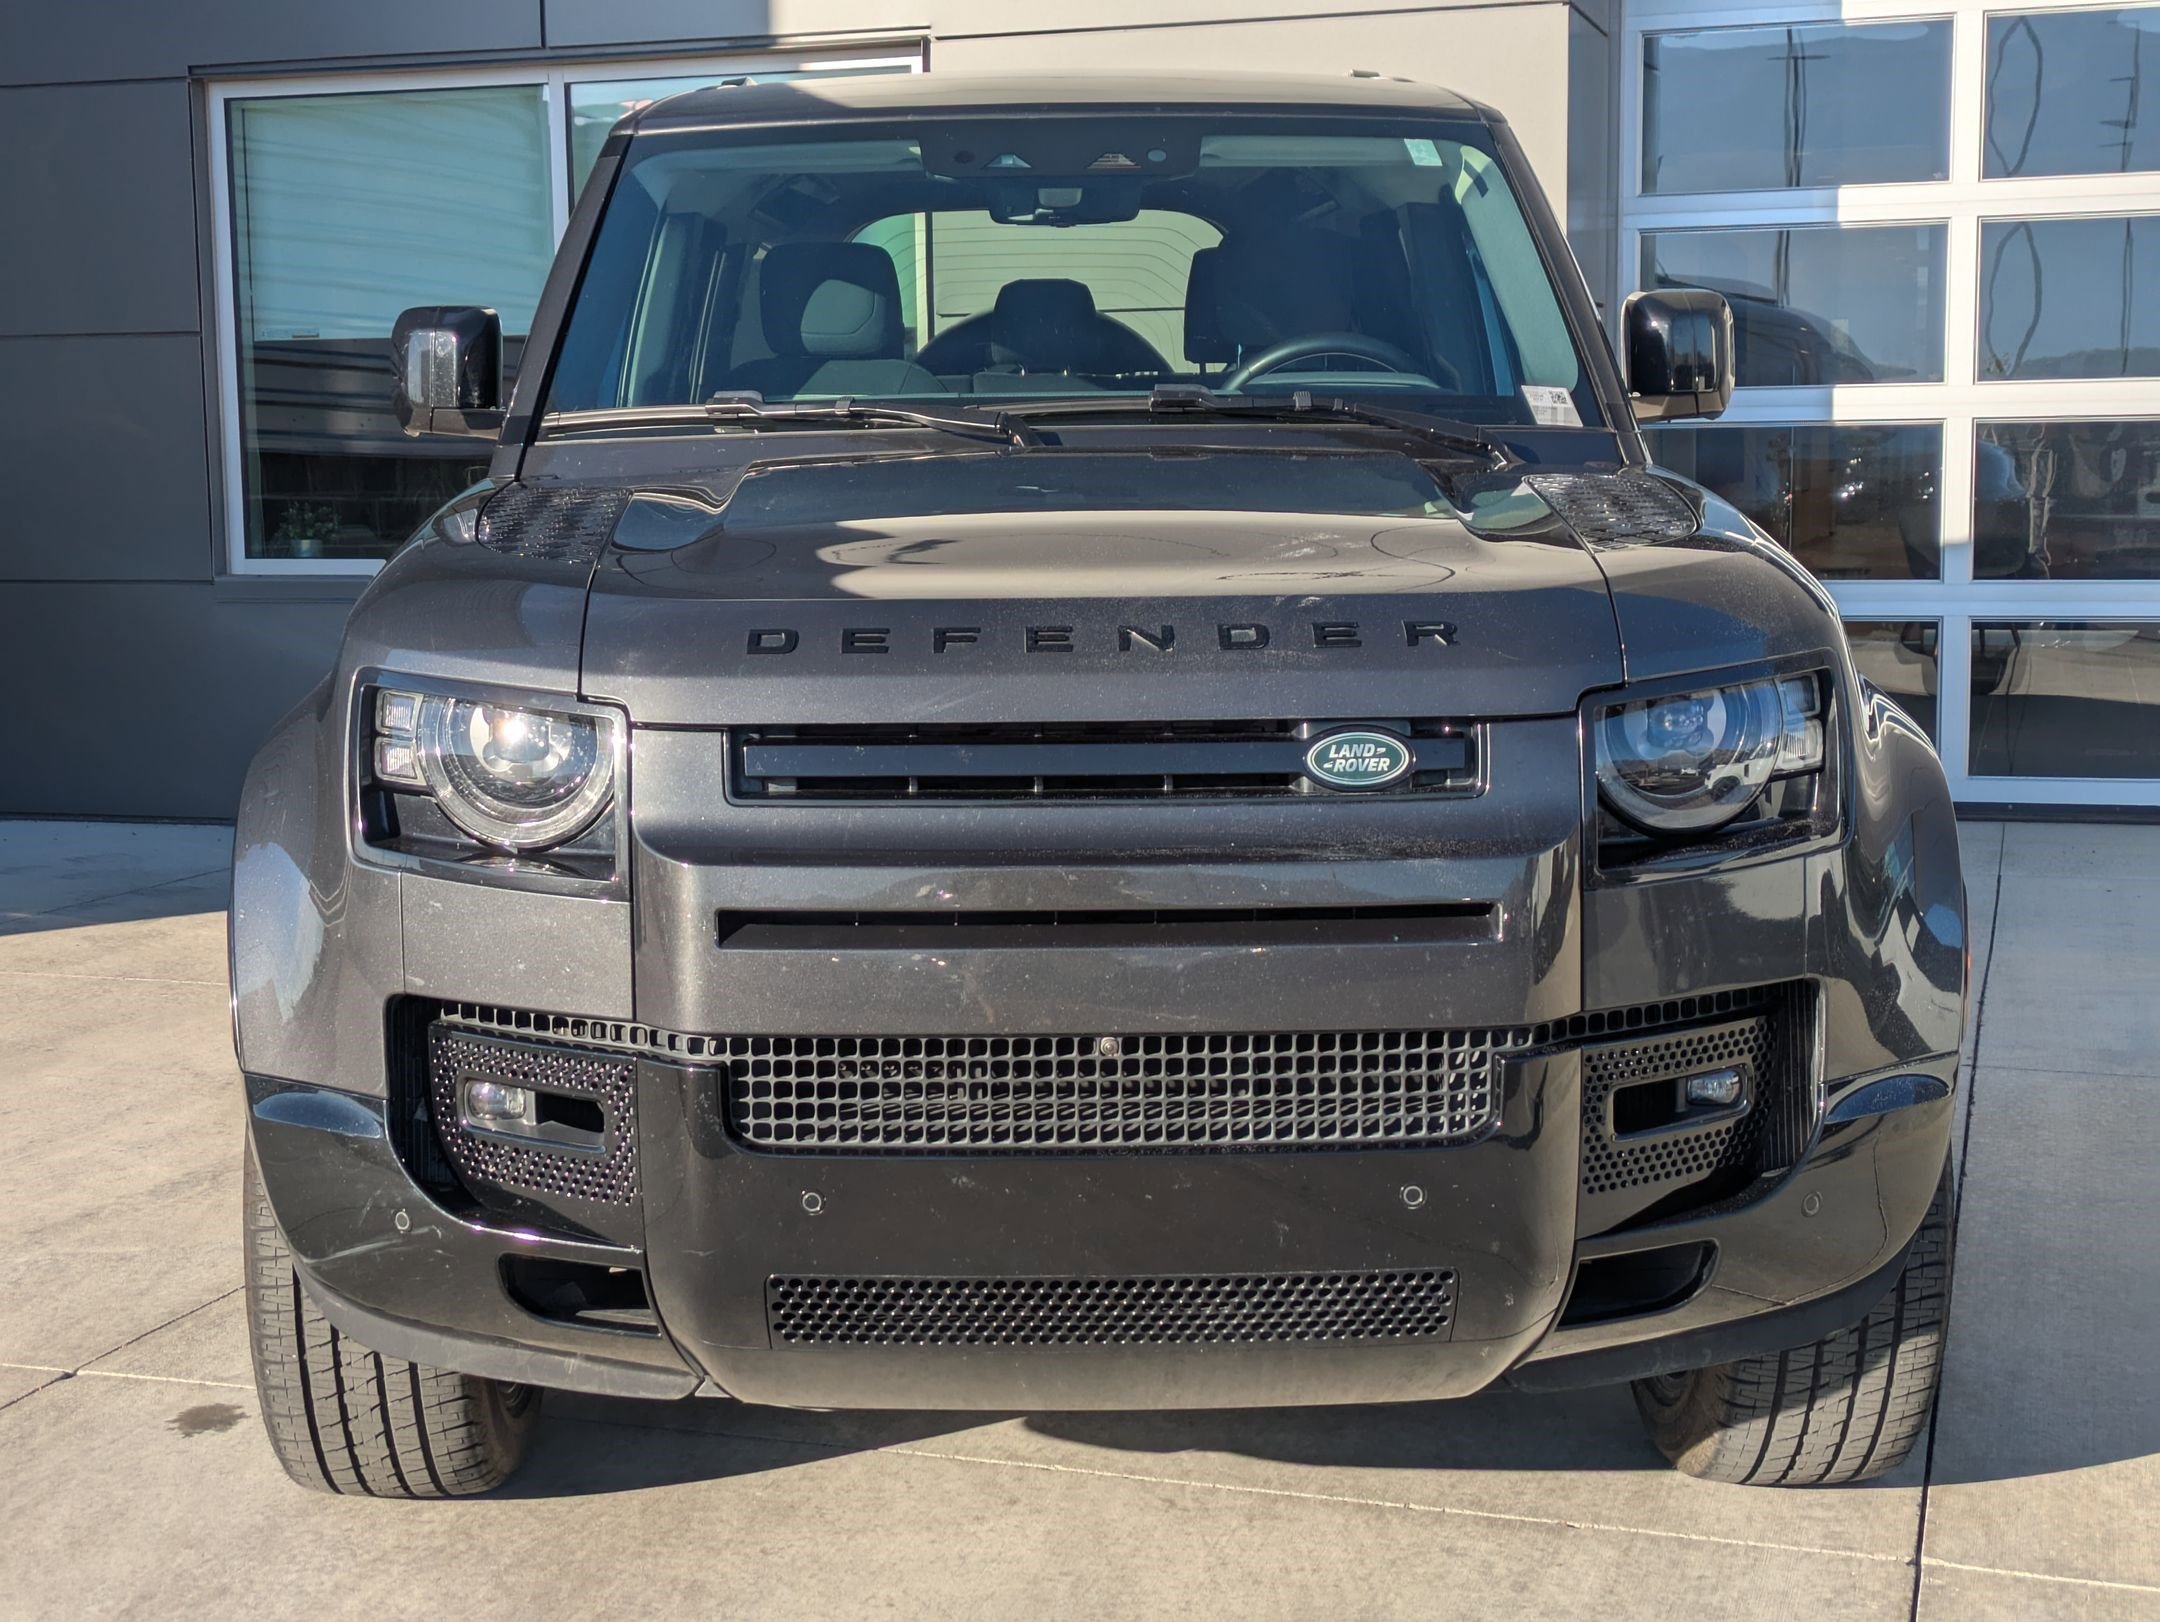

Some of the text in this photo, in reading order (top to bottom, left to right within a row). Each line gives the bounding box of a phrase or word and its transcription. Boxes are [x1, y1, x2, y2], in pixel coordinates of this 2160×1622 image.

[747, 620, 1460, 654] DEFENDER
[1329, 744, 1375, 758] LAND
[1333, 758, 1391, 772] ROVER
